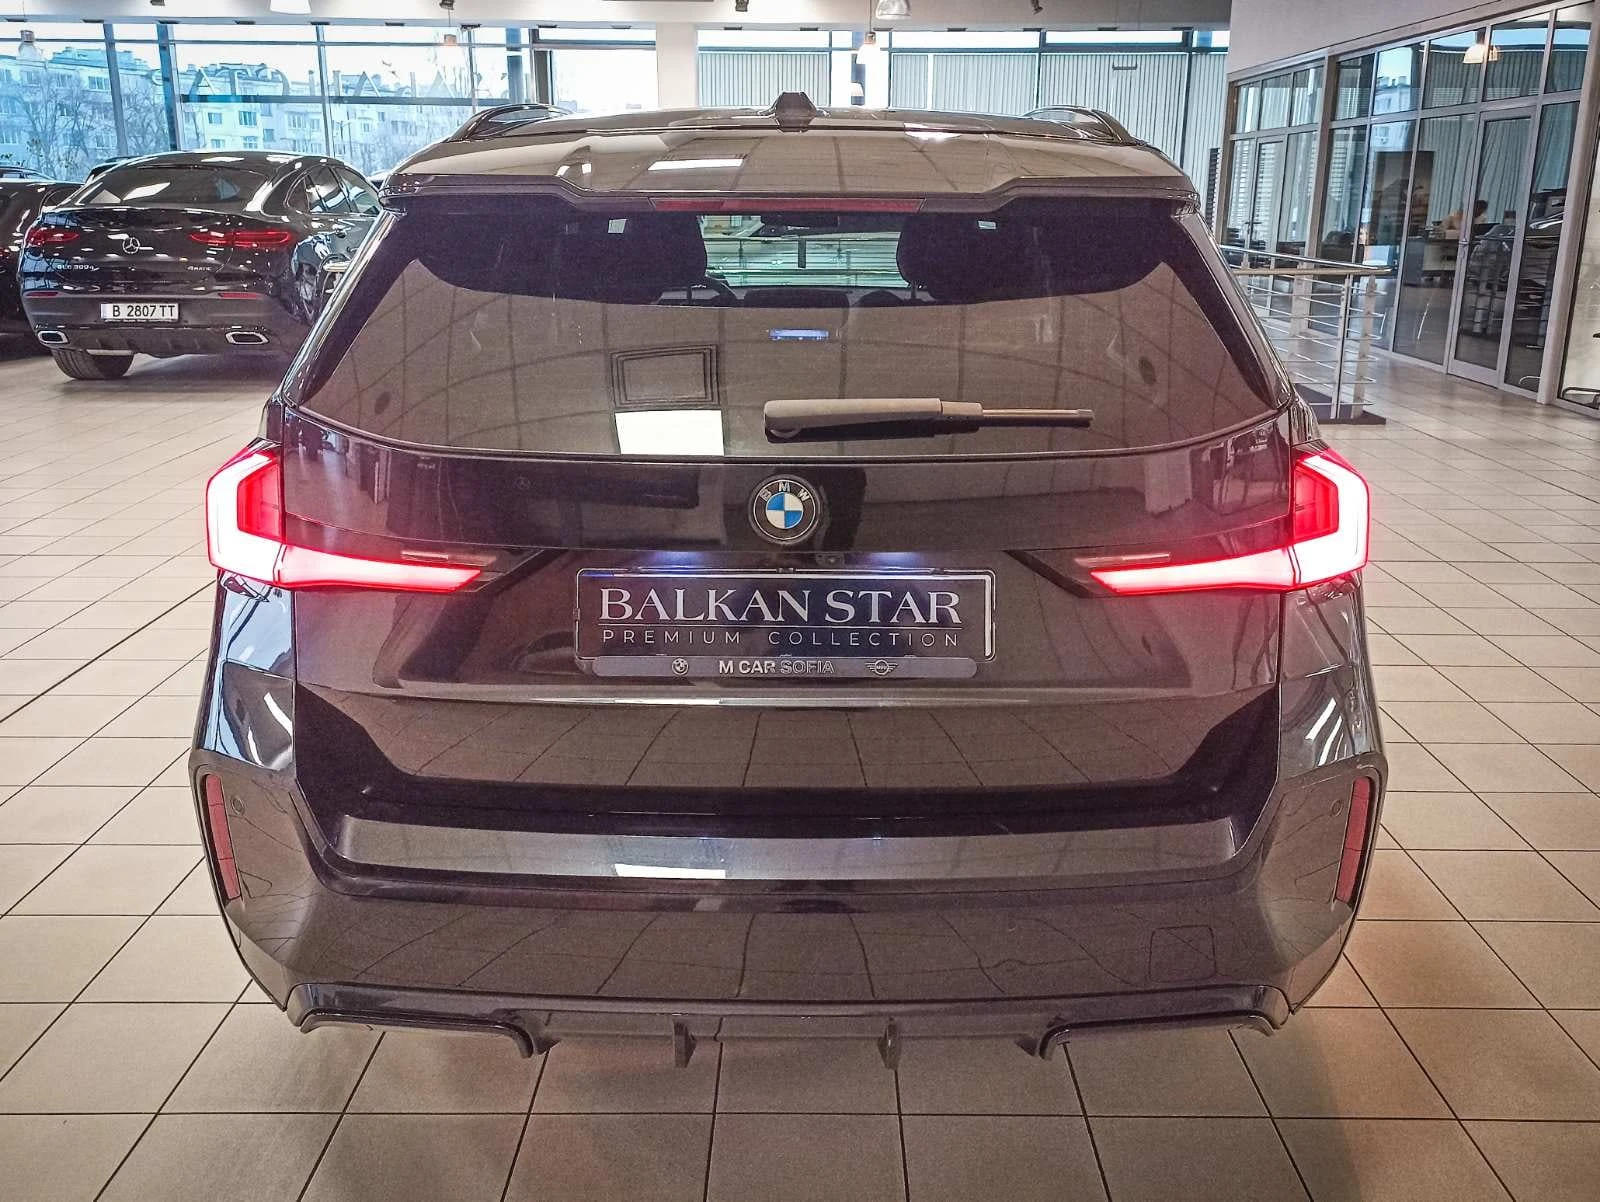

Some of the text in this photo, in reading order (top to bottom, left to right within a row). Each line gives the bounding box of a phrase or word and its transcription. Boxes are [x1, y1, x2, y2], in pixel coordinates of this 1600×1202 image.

[112, 305, 175, 317] B 2807 TT
[759, 480, 810, 502] BMW
[599, 588, 962, 625] BALKAN STAR
[603, 629, 959, 647] PREMIUM COLLECTION
[718, 659, 835, 675] M CAR SOFIA
